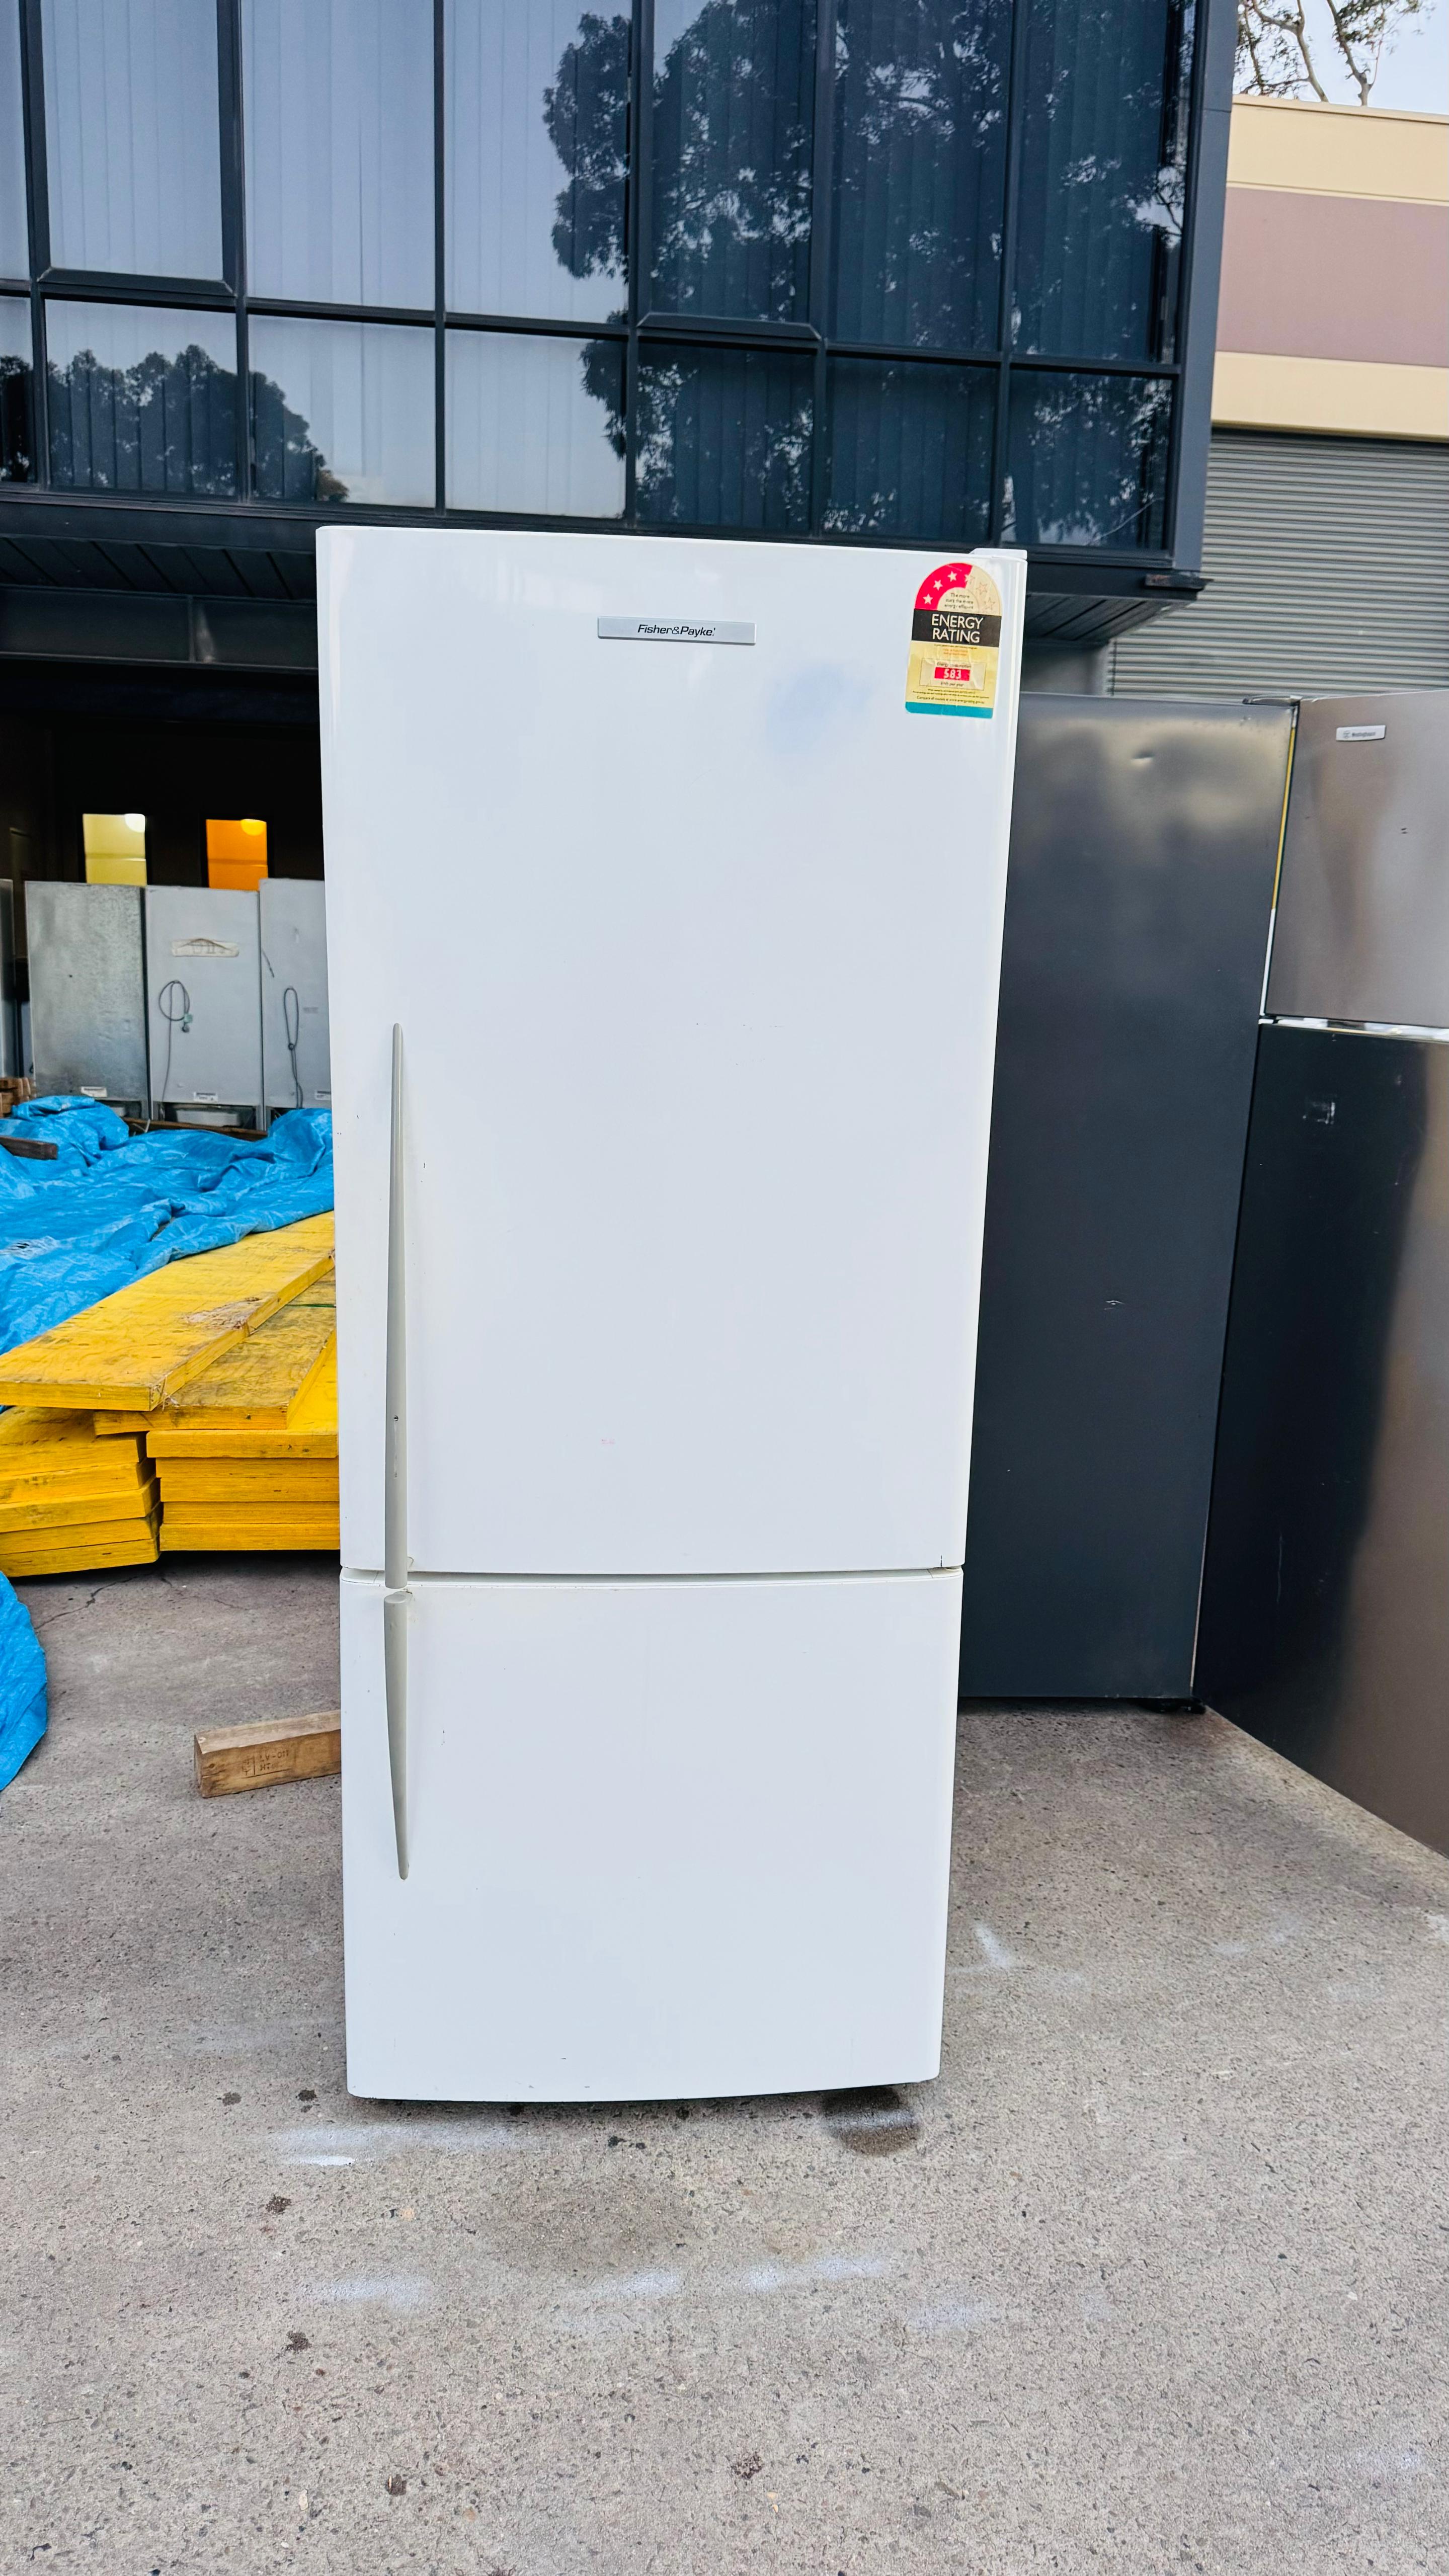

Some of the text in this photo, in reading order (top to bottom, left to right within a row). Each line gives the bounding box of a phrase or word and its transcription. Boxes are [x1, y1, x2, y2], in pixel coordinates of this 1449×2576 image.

[931, 613, 984, 629] ENERGY
[932, 627, 980, 643] RATING
[944, 669, 961, 679] 583
